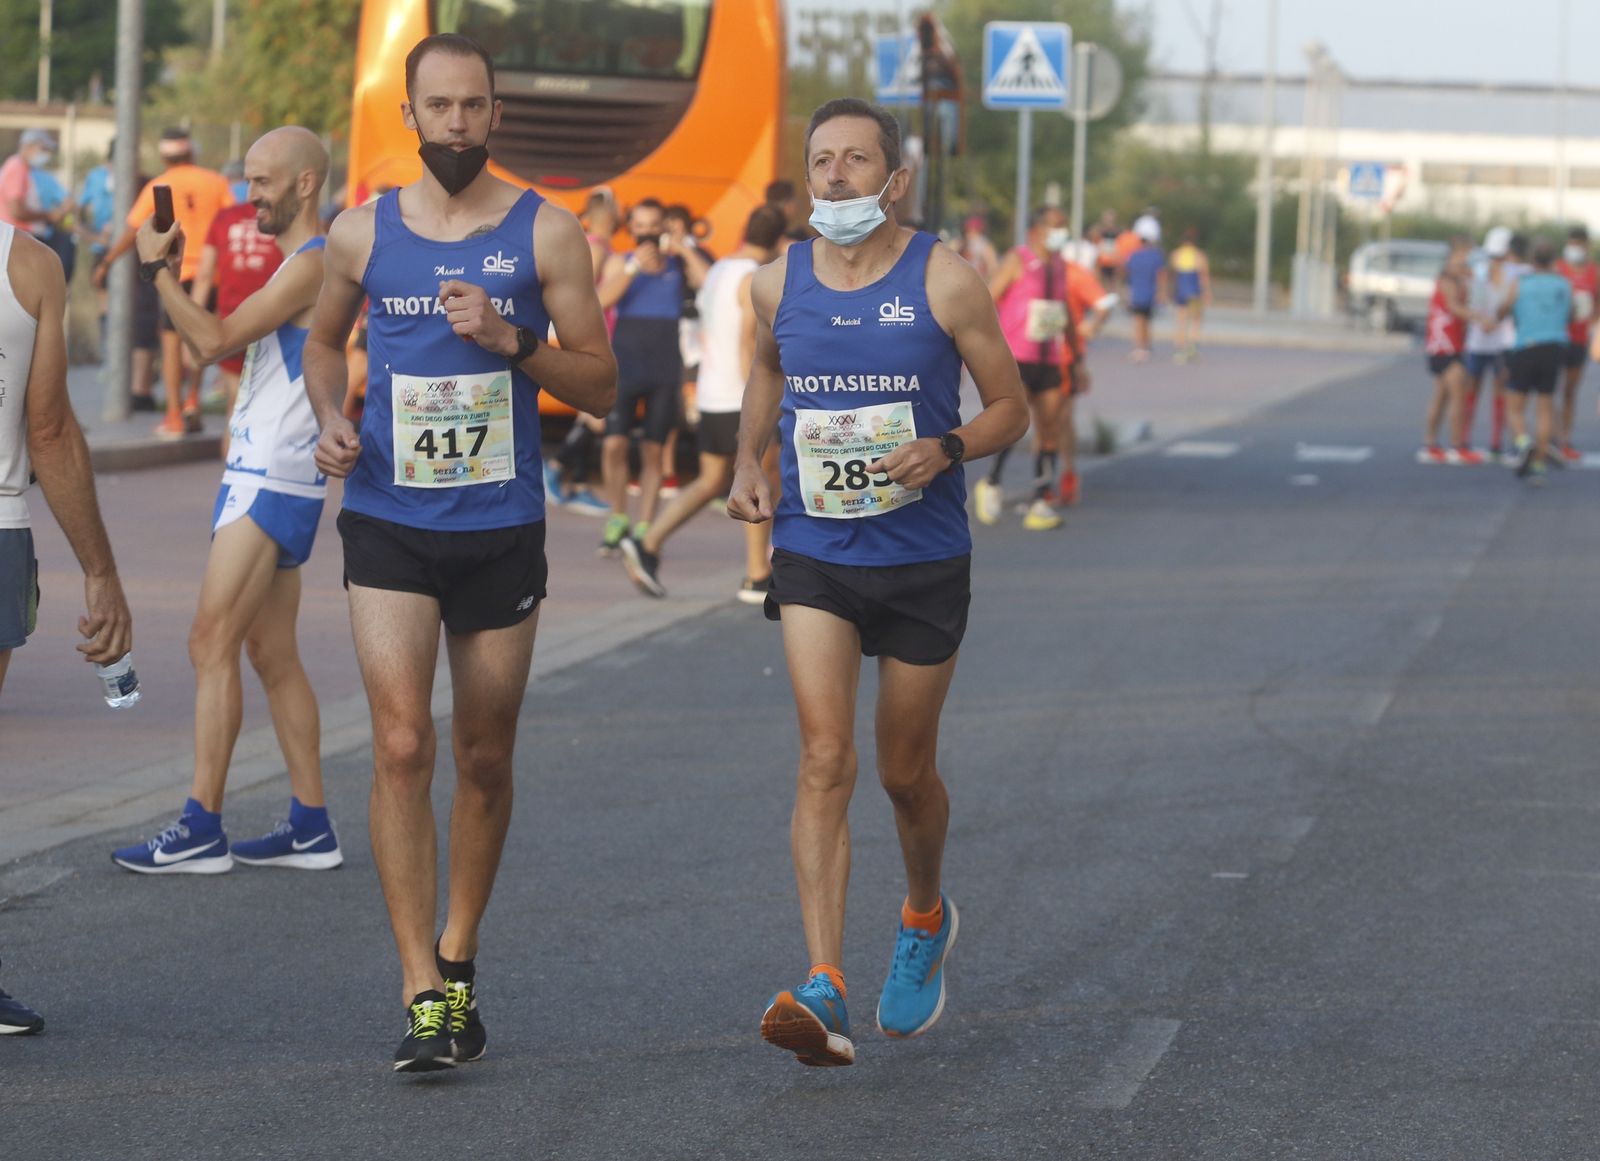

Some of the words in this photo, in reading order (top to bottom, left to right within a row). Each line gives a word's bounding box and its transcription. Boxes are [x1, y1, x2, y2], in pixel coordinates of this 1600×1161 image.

[382, 296, 516, 316] TROTARA
[878, 296, 916, 322] als
[426, 380, 458, 392] XXXV
[786, 374, 920, 393] TROTASIERRA
[828, 414, 857, 426] XXXV
[414, 425, 488, 460] 417
[840, 445, 875, 454] CANTARERO
[876, 442, 899, 450] CUESTA
[841, 496, 882, 506] serizona
